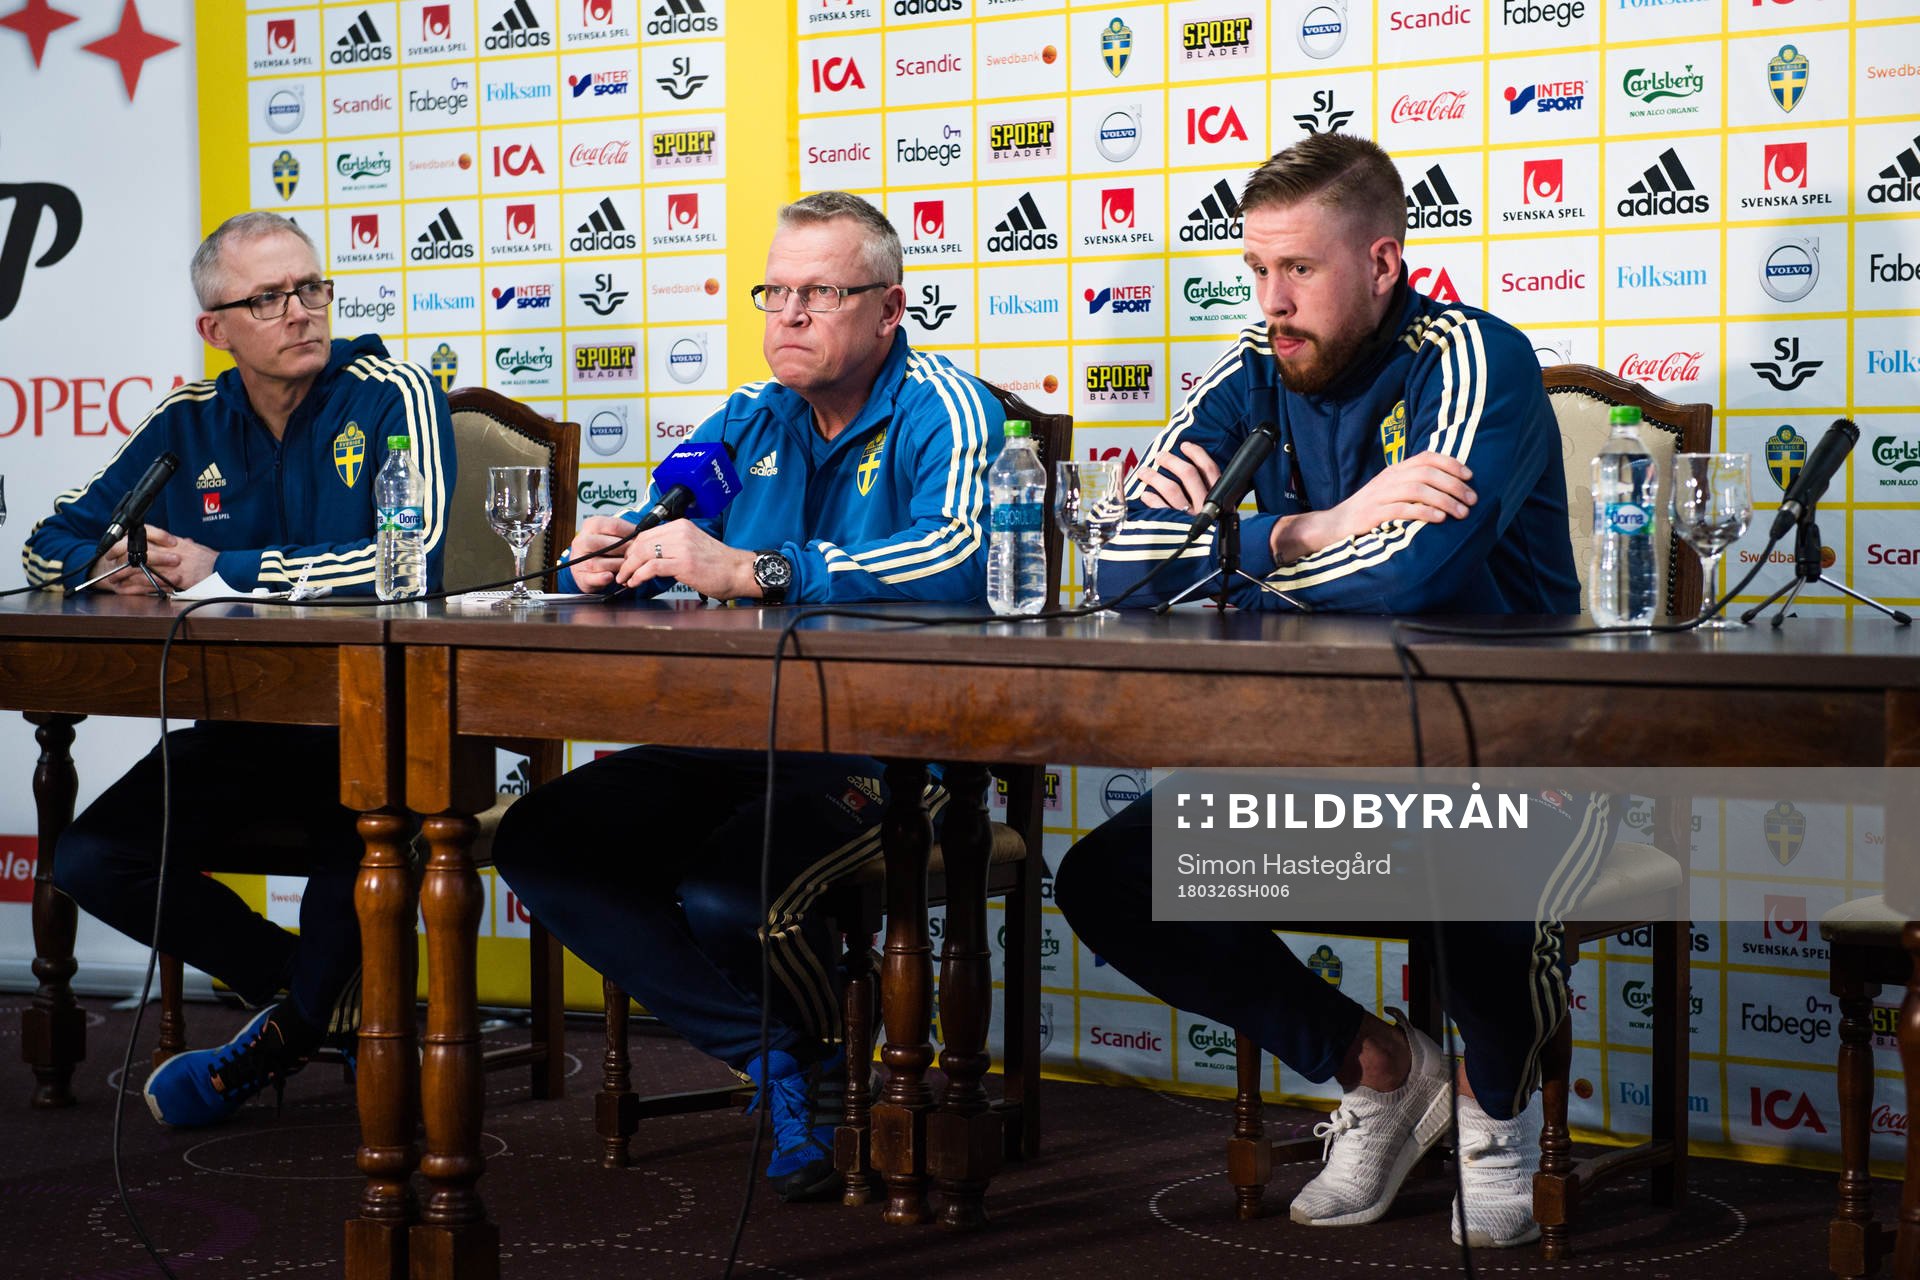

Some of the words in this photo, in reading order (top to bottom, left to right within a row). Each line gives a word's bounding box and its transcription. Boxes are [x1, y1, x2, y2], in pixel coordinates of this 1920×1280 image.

[647, 12, 718, 36] adidas
[809, 12, 847, 23] SVENSKA
[850, 8, 872, 19] SPEL
[1391, 5, 1471, 31] Scandic
[1503, 0, 1585, 28] Fabege
[484, 28, 550, 50] adidas
[567, 31, 606, 42] SVENSKA
[609, 28, 630, 38] SPEL
[1183, 17, 1252, 51] SPORT
[1304, 24, 1341, 35] VOLVO
[330, 43, 392, 65] adidas
[986, 52, 1040, 66] Swedbank
[1186, 46, 1249, 59] BLADET
[253, 59, 290, 69] SVENSKA
[293, 58, 312, 66] SPEL
[672, 57, 691, 76] SJ
[896, 54, 962, 76] Scandic
[594, 70, 628, 83] INTER
[812, 56, 866, 93] ICA
[1623, 68, 1704, 98] Carlsberg
[486, 80, 551, 102] Folksam
[594, 82, 628, 96] SPORT
[1537, 81, 1584, 98] INTER
[333, 94, 392, 114] Scandic
[409, 90, 468, 115] Fabege
[1313, 89, 1334, 113] SJ
[1537, 95, 1584, 113] SPORT
[1629, 110, 1645, 118] NON
[1647, 109, 1665, 117] ALCO
[1667, 106, 1699, 116] ORGANIC
[991, 120, 1054, 150] SPORT
[1102, 128, 1136, 139] VOLVO
[1187, 105, 1249, 145] ICA
[653, 131, 716, 158] SPORT
[808, 143, 871, 164] Scandic
[897, 138, 961, 167] Fabege
[994, 147, 1052, 160] BLADET
[337, 154, 391, 177] Carlsberg
[409, 159, 456, 172] Swedbank
[493, 144, 544, 177] ICA
[656, 155, 713, 166] BLADET
[1617, 191, 1710, 218] adidas
[1741, 195, 1798, 209] SVENSKA
[1802, 193, 1832, 205] SPEL
[1503, 209, 1554, 222] SVENSKA
[1558, 207, 1586, 219] SPEL
[491, 244, 529, 254] SVENSKA
[533, 243, 552, 252] SPEL
[570, 231, 636, 252] adidas
[653, 235, 692, 245] SVENSKA
[696, 233, 718, 242] SPEL
[941, 243, 963, 254] SPEL
[987, 229, 1058, 252] adidas
[1084, 234, 1128, 246] SVENSKA
[1131, 232, 1154, 243] SPEL
[337, 253, 373, 264] SVENSKA
[375, 251, 394, 261] SPEL
[411, 241, 474, 261] adidas
[1617, 264, 1707, 289] Folksam
[1768, 265, 1811, 275] VOLVO
[517, 285, 551, 297] INTER
[595, 273, 612, 293] SJ
[651, 284, 702, 295] Swedbank
[1184, 277, 1251, 304] Carlsberg
[1502, 269, 1586, 293] Scandic
[412, 292, 475, 312] Folksam
[922, 285, 940, 305] SJ
[1112, 285, 1151, 300] INTER
[338, 297, 396, 323] Fabege
[517, 297, 551, 309] SPORT
[989, 295, 1059, 316] Folksam
[1112, 300, 1151, 314] SPORT
[496, 347, 552, 370] Carlsberg
[575, 345, 635, 371] SPORT
[671, 353, 702, 363] VOLVO
[1774, 337, 1800, 363] SJ
[579, 369, 633, 378] BLADET
[1087, 364, 1152, 393] SPORT
[1090, 391, 1150, 401] BLADET
[591, 426, 623, 435] VOLVO
[196, 478, 227, 489] adidas
[578, 481, 637, 504] Carlsberg
[1740, 550, 1795, 564] Swdba
[1743, 943, 1798, 957] SVENSKA
[1802, 946, 1830, 960] SPEL
[1742, 1002, 1831, 1044] Fabege
[1091, 1026, 1162, 1051] Scandic
[1751, 1086, 1827, 1134] ICA
